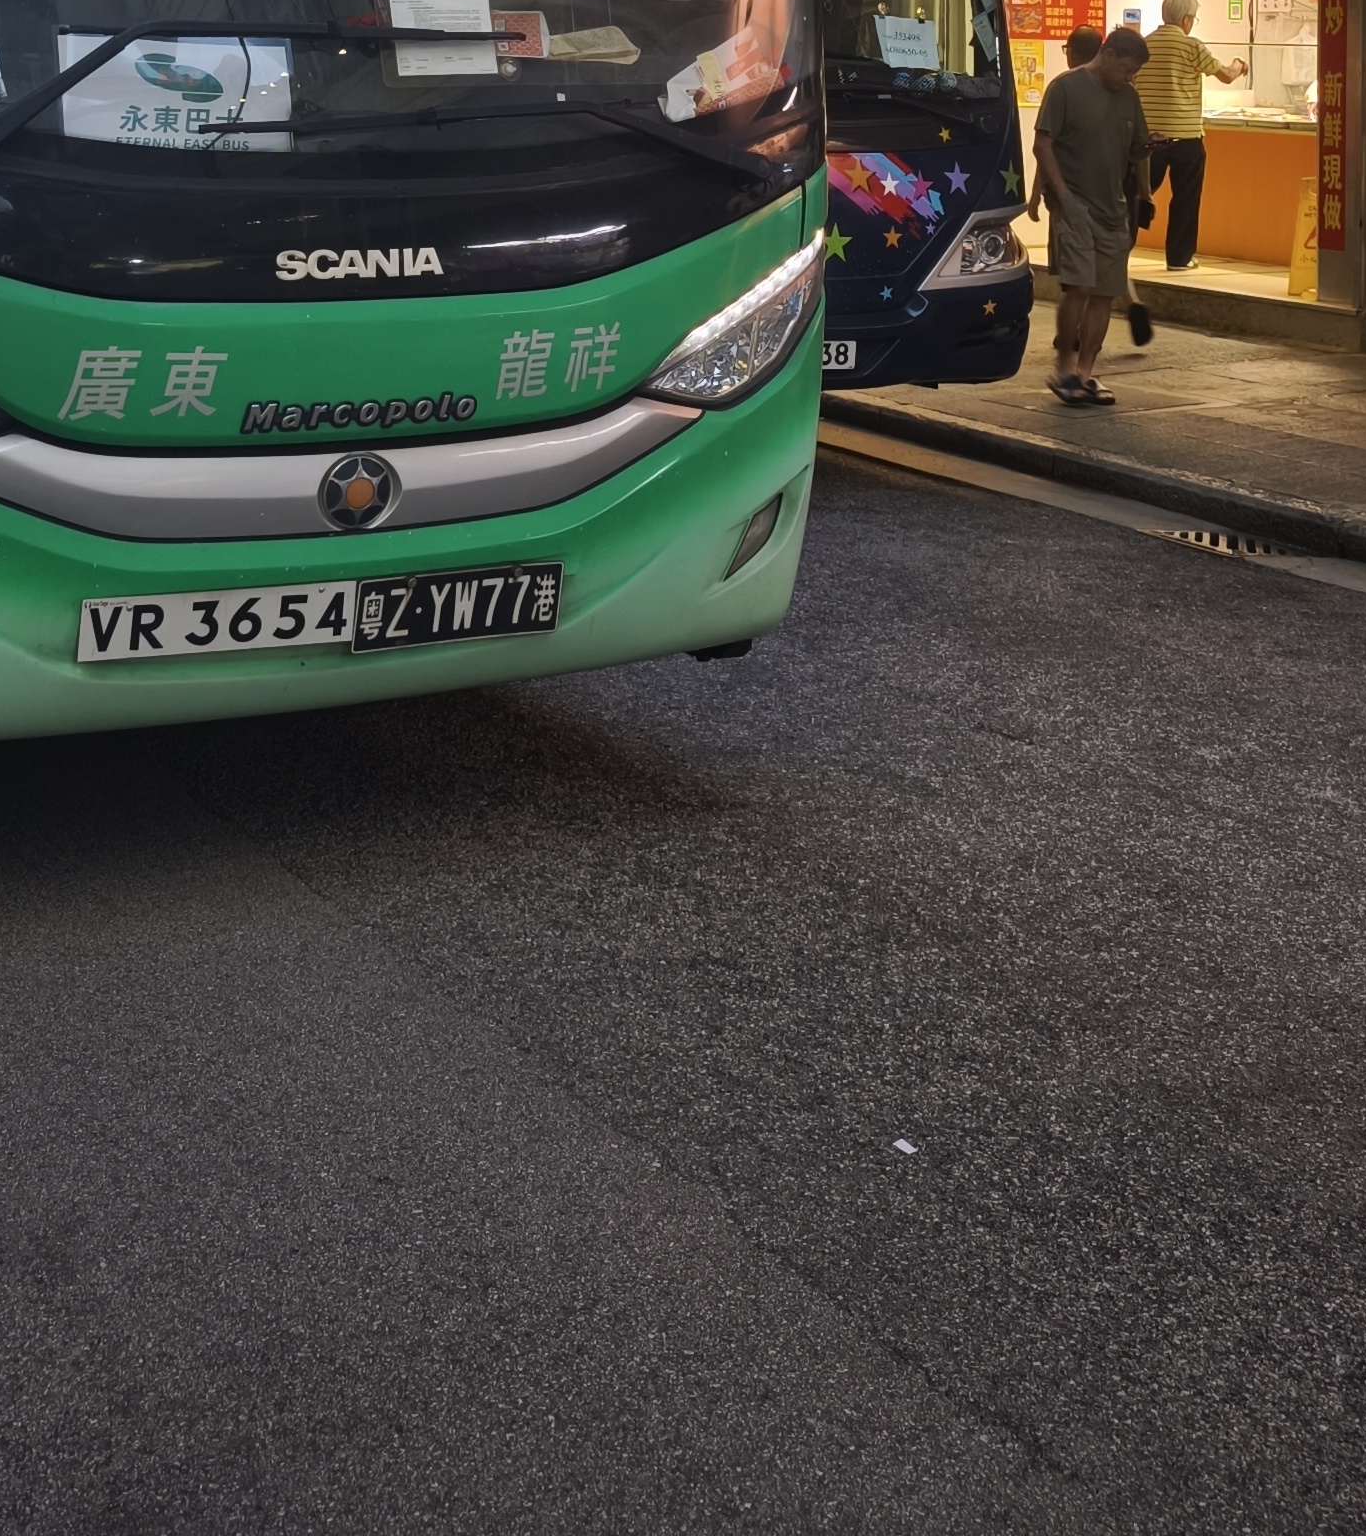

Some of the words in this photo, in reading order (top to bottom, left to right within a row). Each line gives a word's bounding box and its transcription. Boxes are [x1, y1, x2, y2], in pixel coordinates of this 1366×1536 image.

[119, 104, 243, 135] 永東巴士
[223, 140, 250, 151] BUS
[1322, 71, 1343, 231] 新鮮現做
[275, 247, 444, 280] SCANIA
[57, 345, 228, 420] 廣東
[496, 321, 621, 400] 龍祥
[241, 394, 477, 433] Marcopolo
[89, 603, 166, 653] VR
[184, 591, 348, 647] 3654
